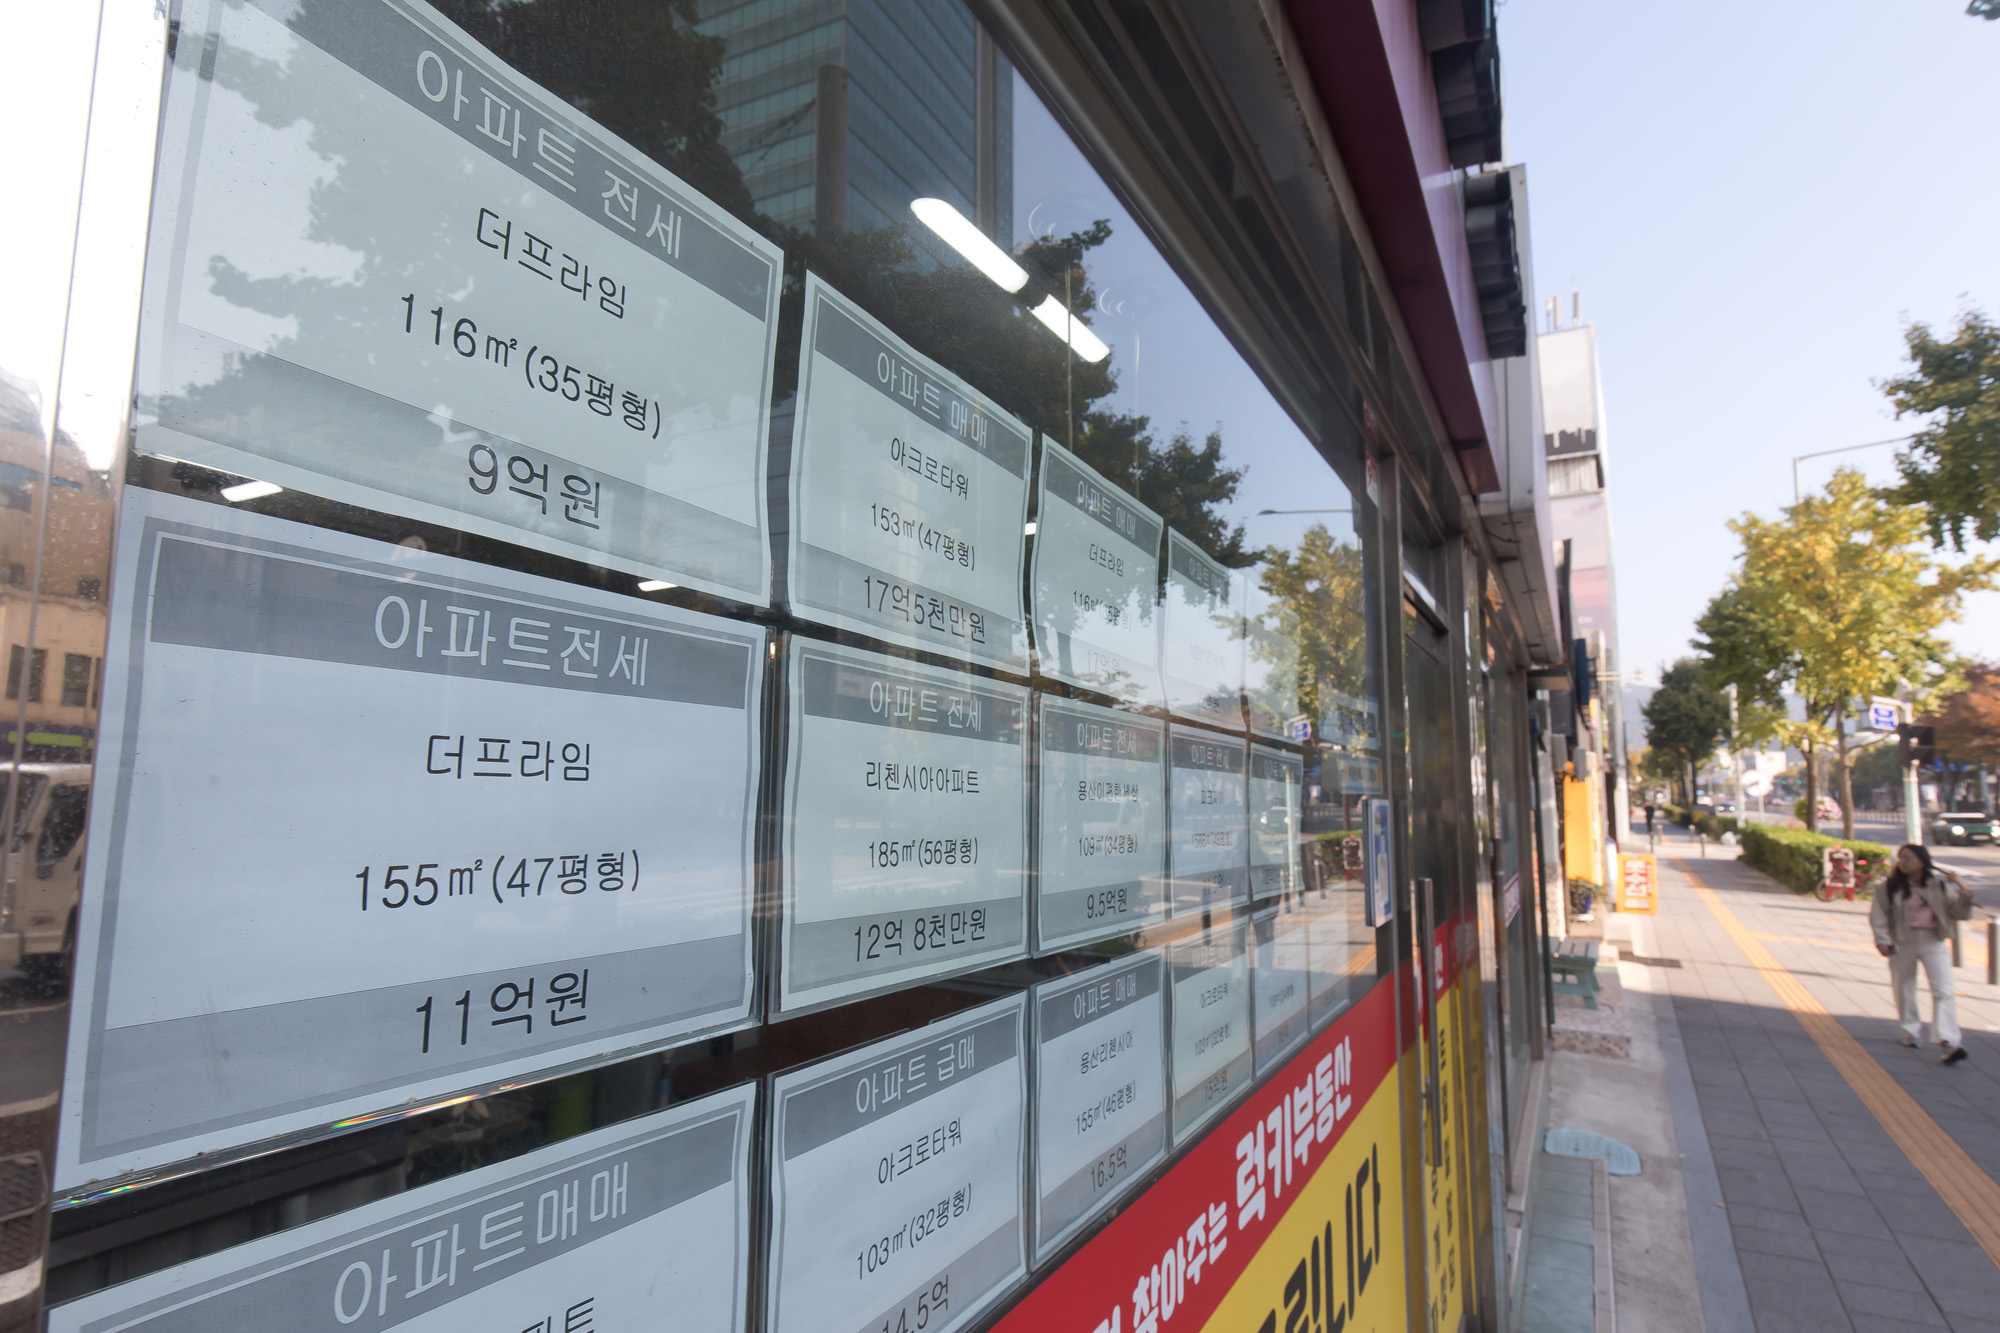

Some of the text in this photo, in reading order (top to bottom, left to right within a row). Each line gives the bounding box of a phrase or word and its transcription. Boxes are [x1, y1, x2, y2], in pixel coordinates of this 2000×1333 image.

[416, 50, 681, 259] 아파트 전세
[475, 206, 627, 319] 더프라임
[877, 352, 988, 450] 아파트 매매
[467, 442, 601, 530] 9억원
[890, 437, 969, 501] 아크로타워
[1077, 480, 1136, 540] 아파트 매매
[1089, 543, 1123, 577] 더프라임
[374, 594, 649, 687] 아파트전세
[864, 575, 987, 644] 17억5천만원
[869, 680, 982, 732] 아파트 전세
[426, 734, 591, 782] 더프라임
[1077, 723, 1137, 756] 아파트 전세
[866, 761, 980, 794] 리첸시아아파트
[1087, 888, 1127, 919] 9.5억원
[854, 908, 987, 963] 12억 8천만원
[415, 967, 589, 1053] 11억원
[1074, 972, 1137, 1019] 아파트 매매
[856, 1034, 975, 1114] 아파트 급매
[1080, 1030, 1133, 1074] 용산리첸시아
[878, 1117, 962, 1185] 아크로타워
[1091, 1144, 1127, 1193] 16.5억
[1132, 1035, 1352, 1333] 찾아주는 럭키부동산
